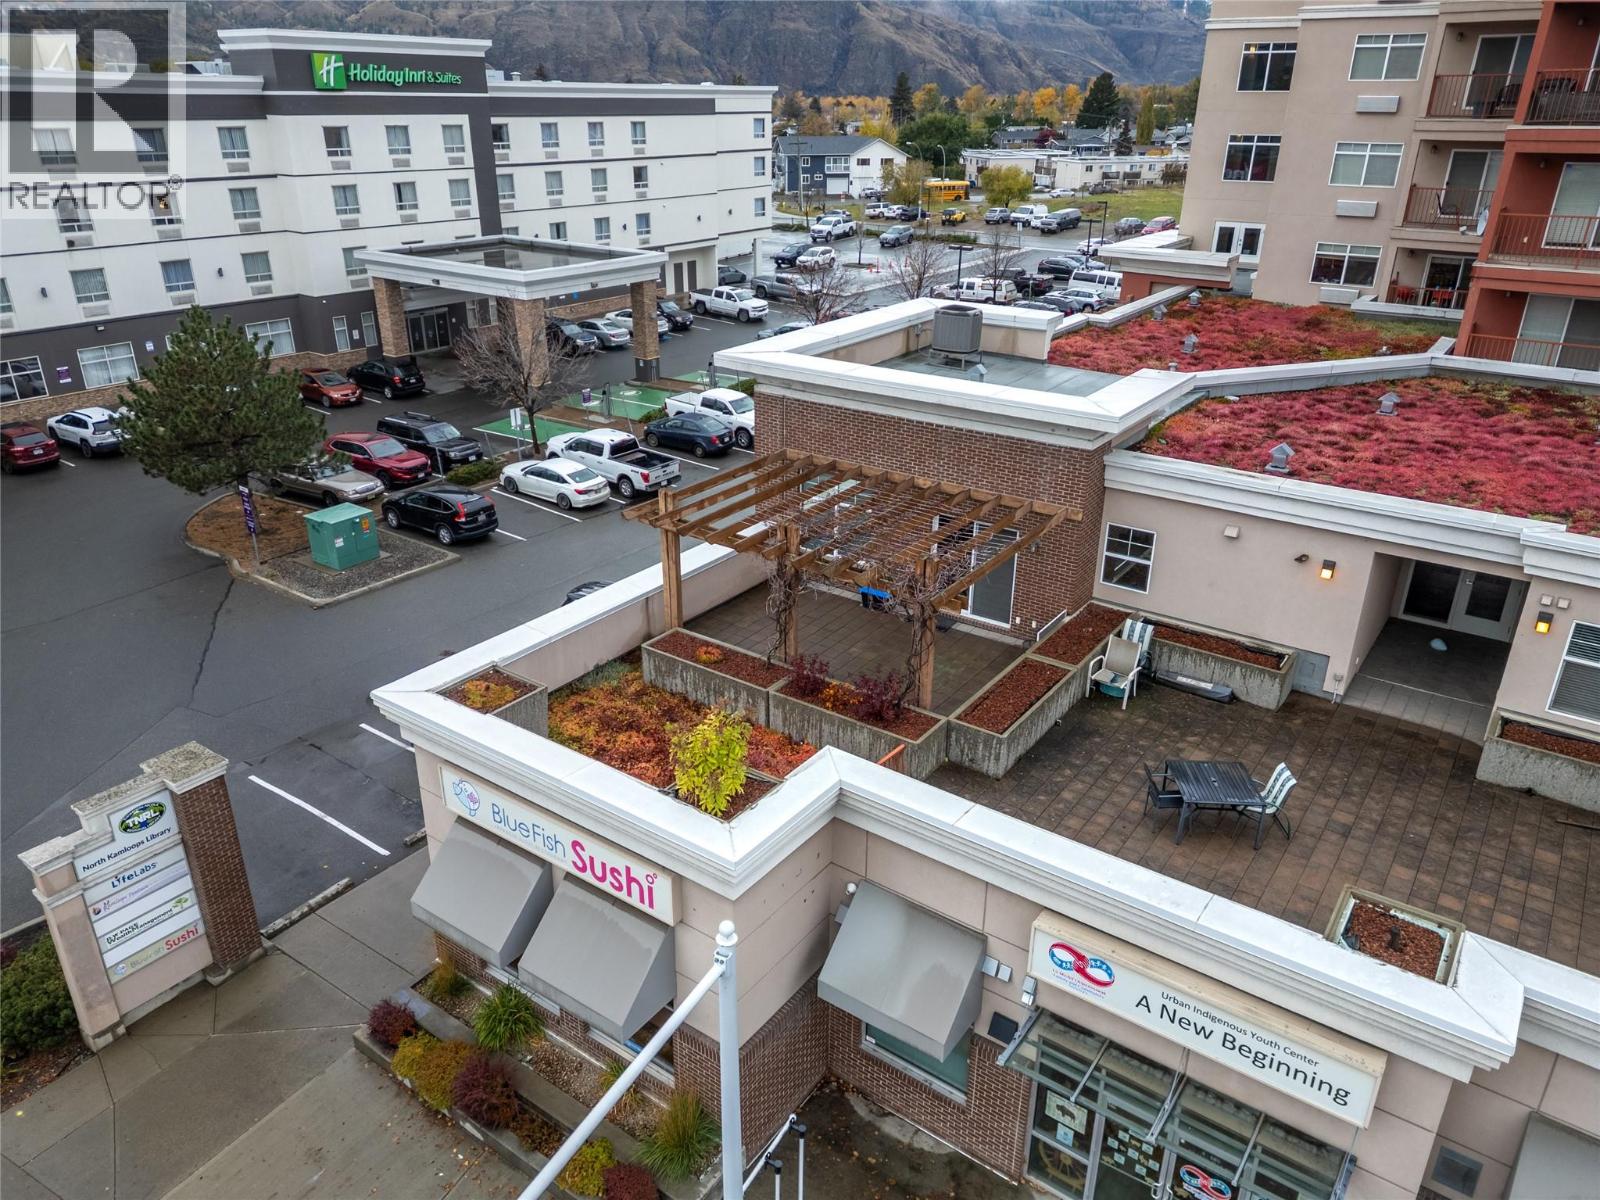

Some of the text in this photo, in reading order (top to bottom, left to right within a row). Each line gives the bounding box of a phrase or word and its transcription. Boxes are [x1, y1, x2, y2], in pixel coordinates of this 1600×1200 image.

[349, 63, 462, 86] Holiday Inn & Suites
[126, 809, 159, 827] TNRL
[82, 827, 171, 872] North Kamloops Library
[492, 803, 657, 909] BlueFish Sushi
[111, 862, 157, 888] LifeLabs
[132, 908, 173, 932] Management
[165, 923, 199, 950] Sushi
[1161, 992, 1319, 1067] Urban Indigenous Youth Center
[1136, 995, 1351, 1106] A New Beginning
